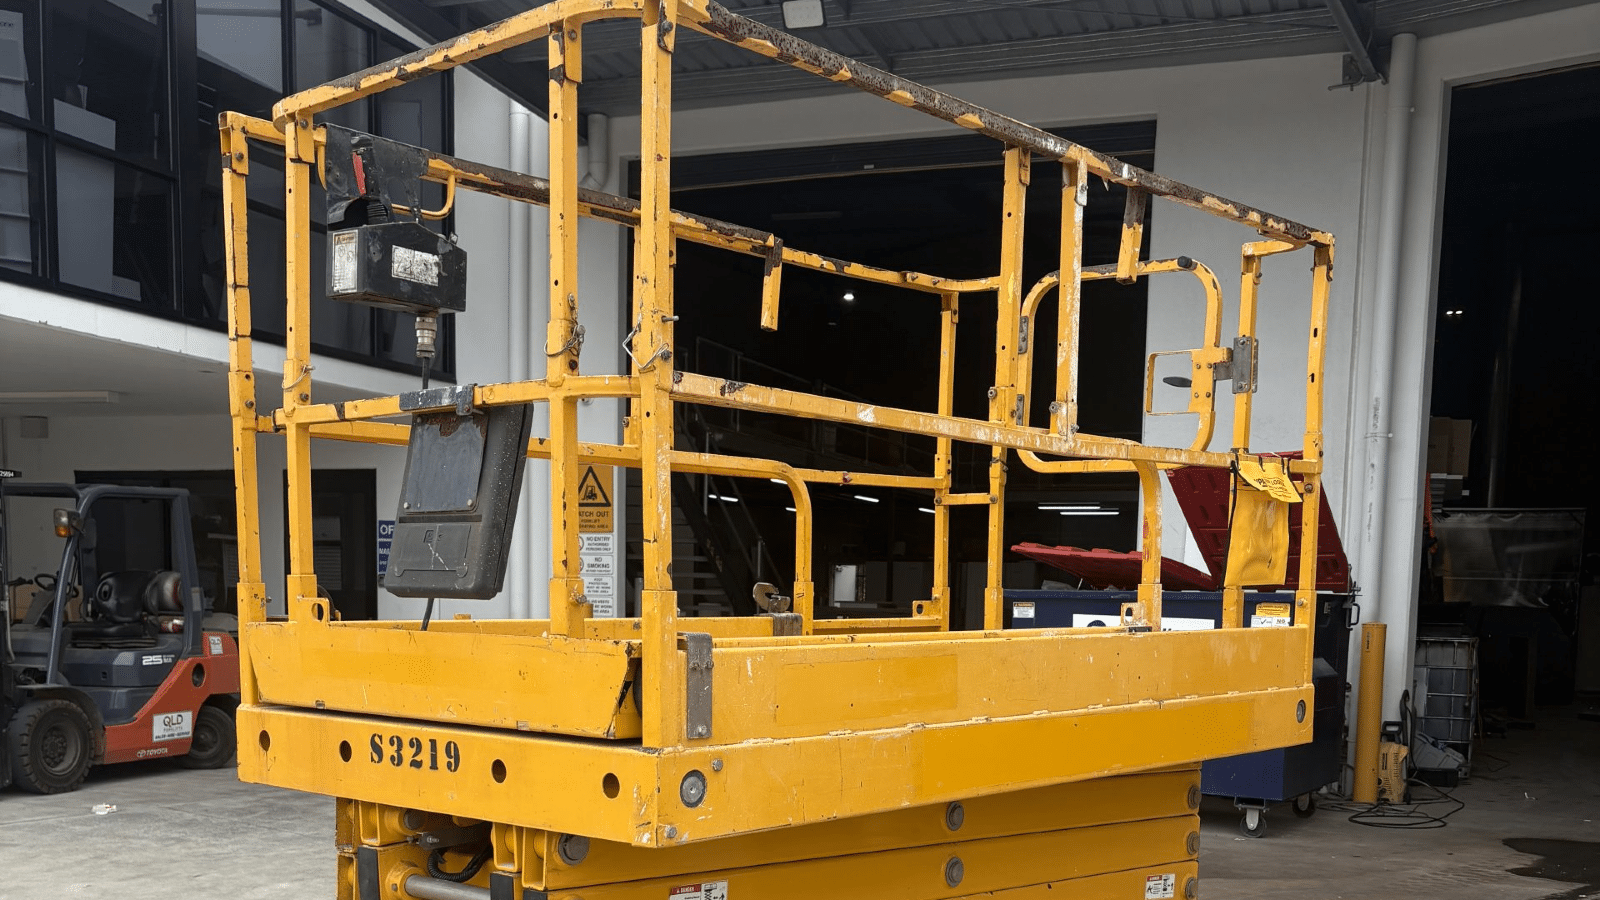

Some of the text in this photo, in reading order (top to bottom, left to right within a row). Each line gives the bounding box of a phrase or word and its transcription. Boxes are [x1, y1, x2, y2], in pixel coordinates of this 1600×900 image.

[579, 510, 609, 518] ATCH OUT
[142, 654, 163, 666] 25
[163, 714, 183, 728] QLD
[146, 748, 168, 756] TOYOTA
[370, 733, 460, 773] S3219
